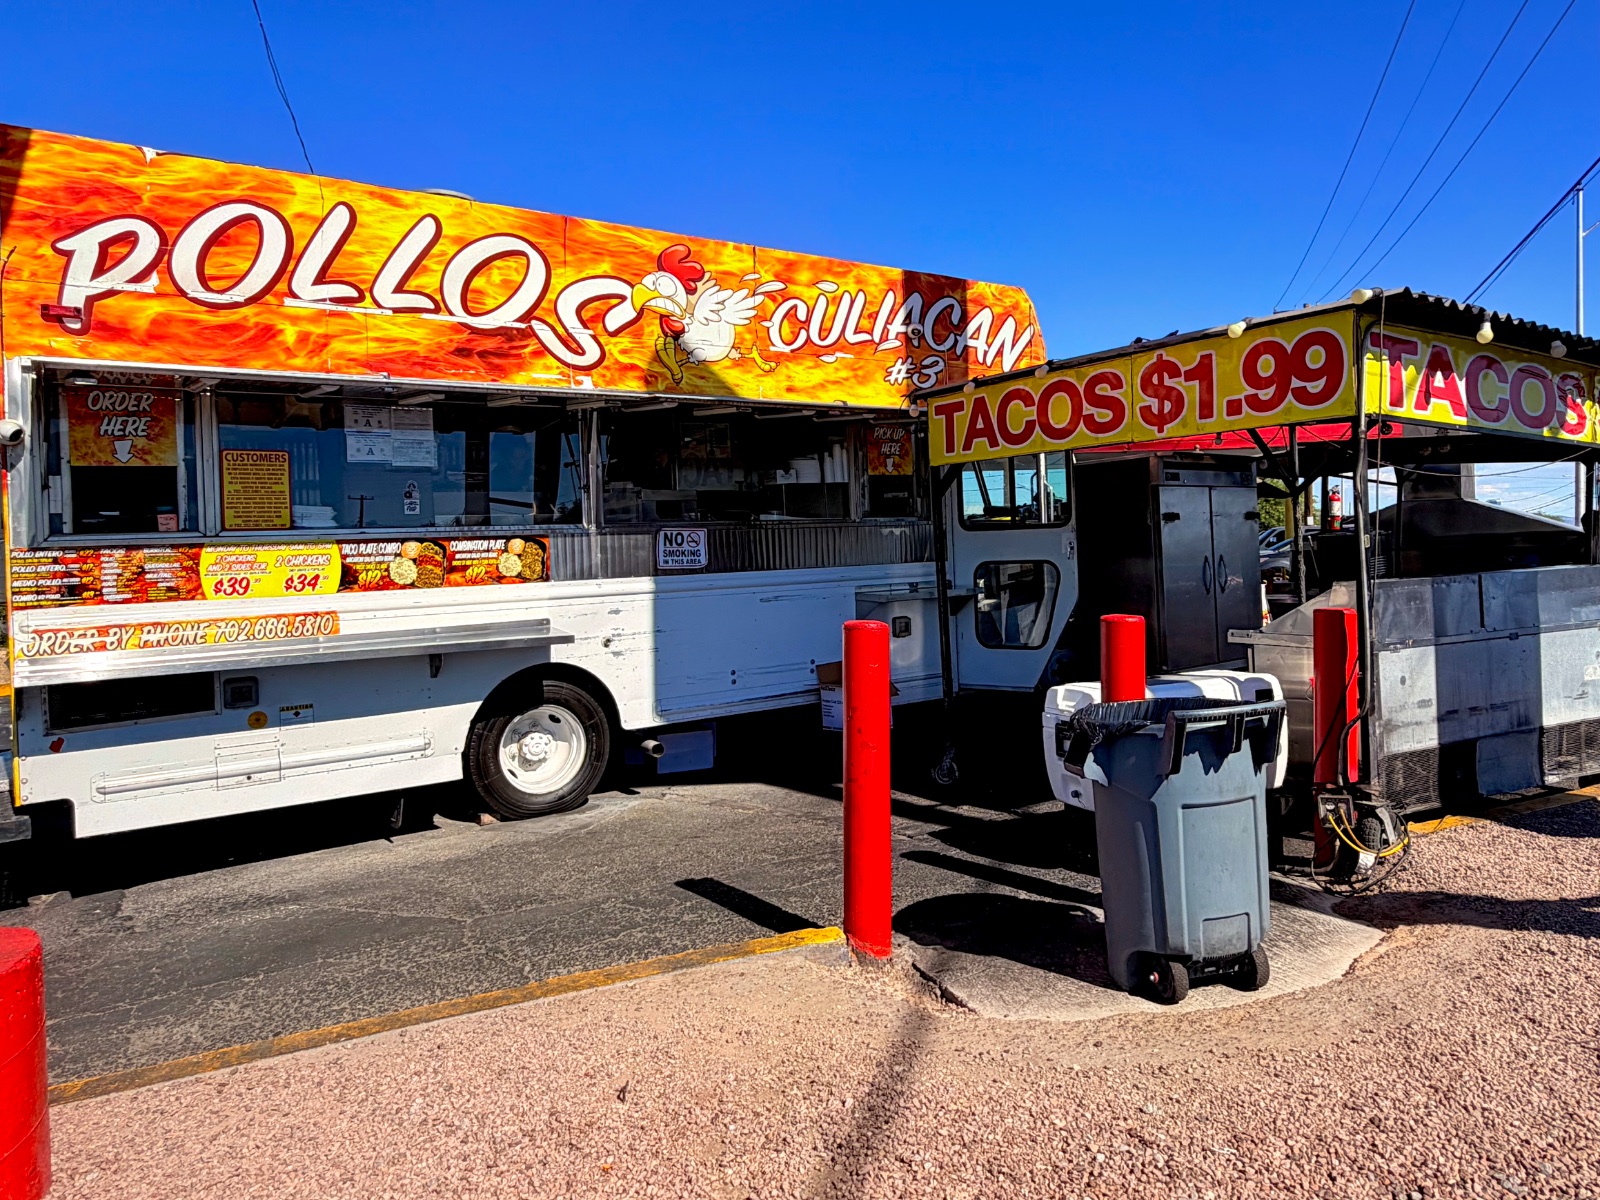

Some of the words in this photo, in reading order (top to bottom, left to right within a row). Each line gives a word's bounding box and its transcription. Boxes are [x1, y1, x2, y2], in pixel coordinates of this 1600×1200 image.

[52, 200, 638, 371] POLLOS
[769, 289, 1034, 374] CULIACAN
[885, 358, 945, 388] #3
[1368, 331, 1588, 437] TACOS
[933, 367, 1129, 456] TACOS
[1137, 326, 1347, 435] $1.99
[87, 390, 155, 412] ORDER
[99, 415, 152, 437] HERE
[363, 418, 372, 428] A
[874, 427, 893, 440] PICK
[894, 428, 906, 440] UP
[366, 447, 375, 456] A
[881, 442, 902, 454] HERE
[224, 452, 287, 463] CUSTOMERS
[664, 532, 684, 546] NO
[205, 545, 239, 553] MONDAY
[251, 544, 287, 552] THURSDAY
[342, 544, 358, 554] TACO
[359, 542, 379, 554] PLATE
[379, 542, 402, 553] COMBO
[450, 540, 488, 552] COMBINATION
[488, 540, 506, 550] PLATE
[10, 550, 34, 558] POLLO
[34, 550, 63, 558] ENTERO
[222, 554, 257, 562] CHICKENS
[662, 549, 702, 558] SMOKING
[274, 555, 283, 568] 2
[284, 554, 331, 566] CHICKENS
[207, 564, 223, 572] AND
[232, 563, 252, 571] SIDES
[20, 628, 98, 658] ORDER
[105, 625, 136, 651] BY
[138, 619, 210, 649] PHONE
[214, 614, 335, 644] 702.666.5810
